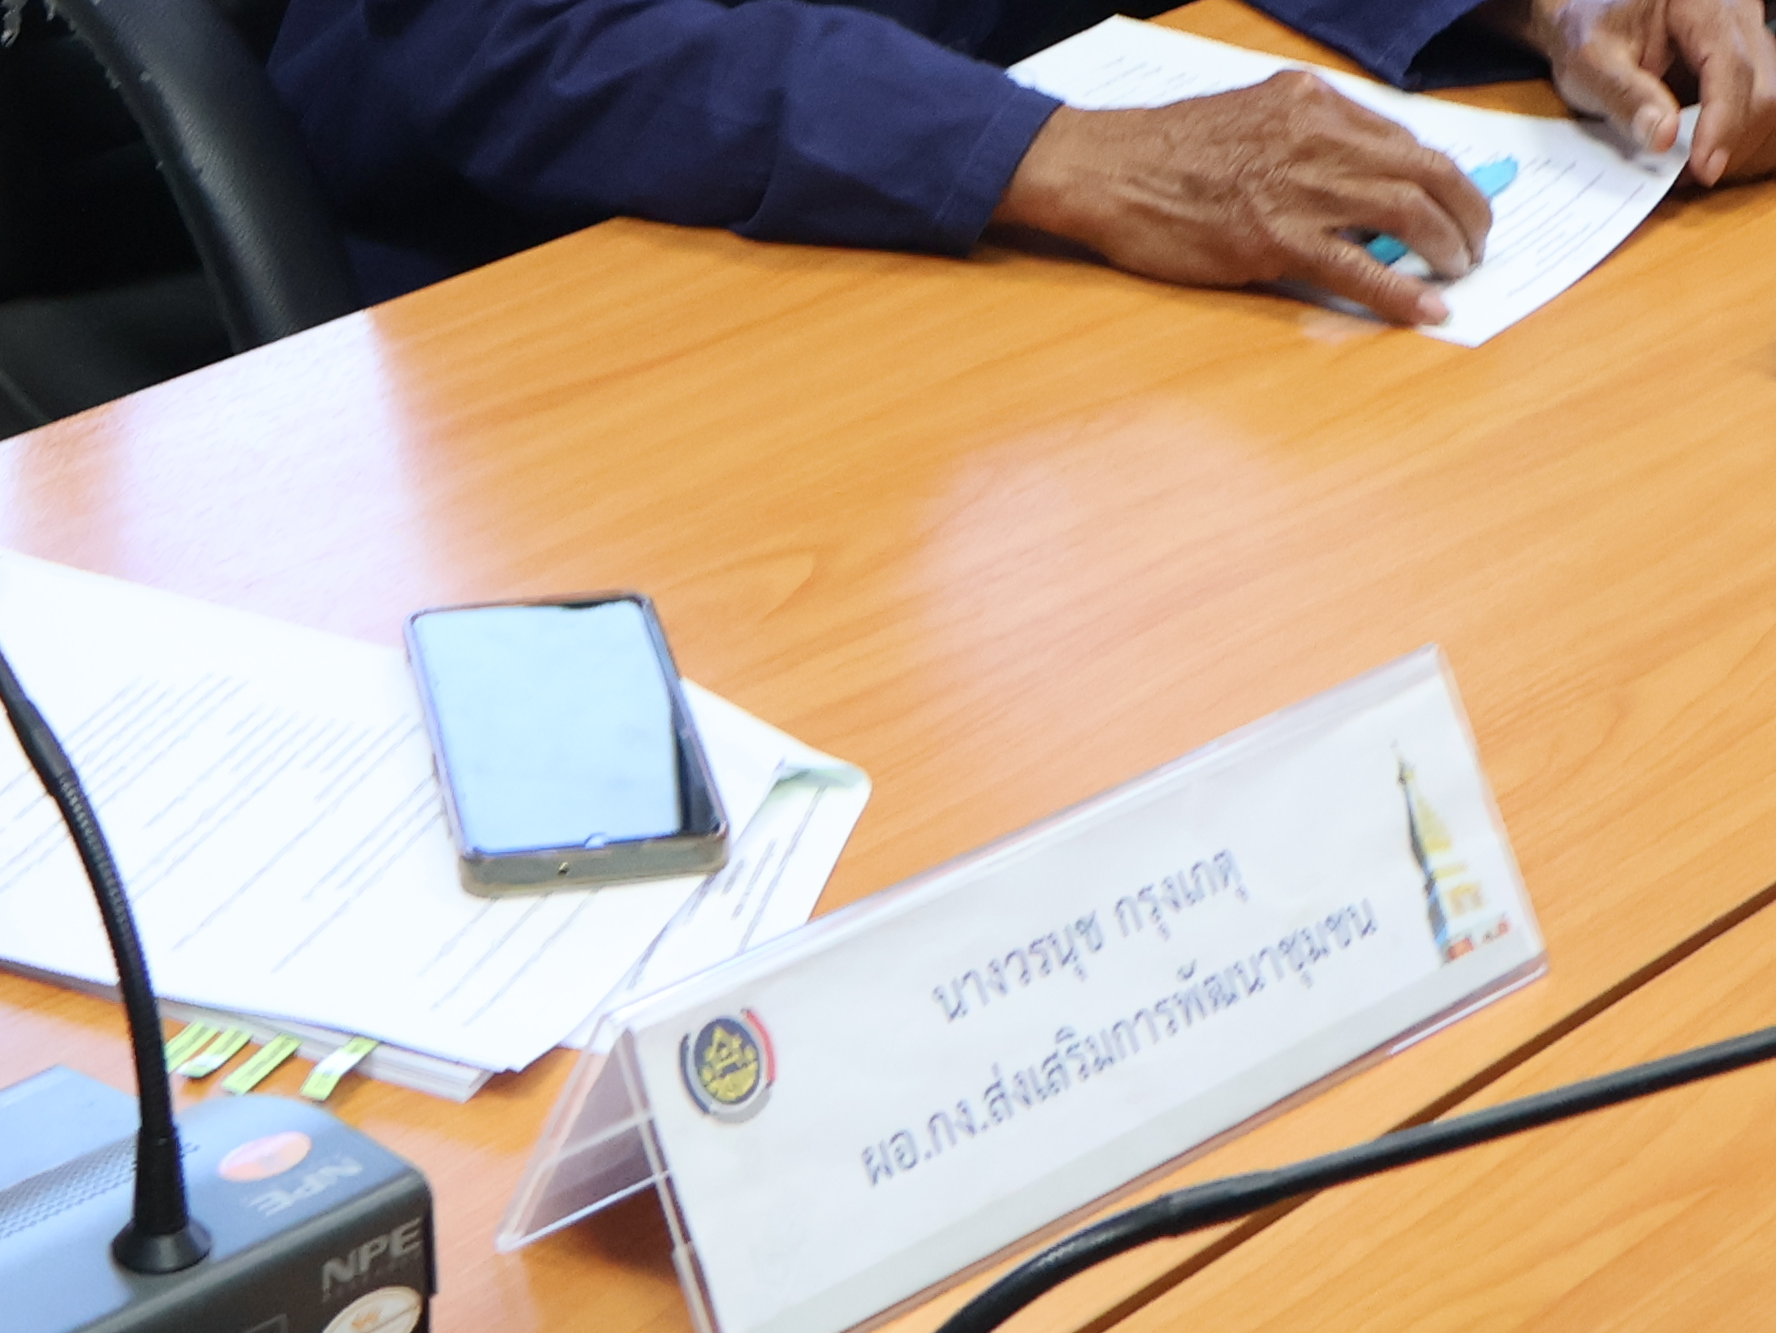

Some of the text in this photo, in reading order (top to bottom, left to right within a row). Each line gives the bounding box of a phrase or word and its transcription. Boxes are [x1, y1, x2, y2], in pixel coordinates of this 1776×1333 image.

[930, 918, 1111, 1025] นางวรนุช
[246, 1156, 364, 1218] NPE
[321, 1216, 423, 1303] NPE
